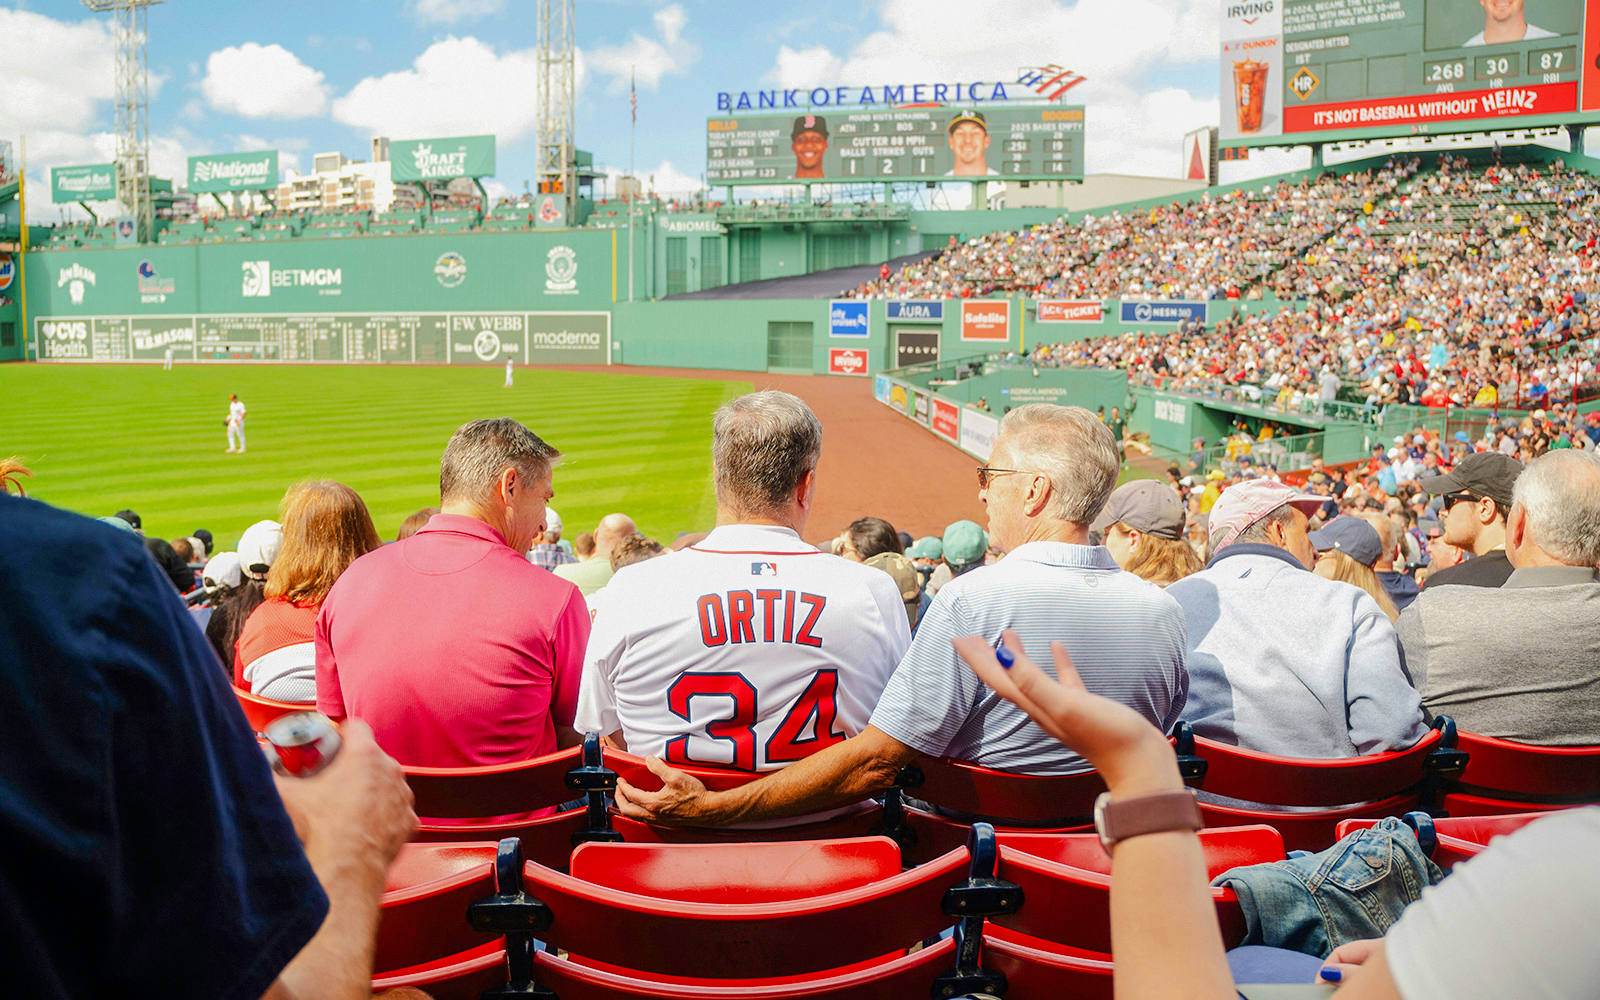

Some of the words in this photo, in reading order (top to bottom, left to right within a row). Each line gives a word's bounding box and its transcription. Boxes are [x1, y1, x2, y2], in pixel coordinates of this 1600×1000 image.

[1228, 1, 1274, 18] IRVING
[1315, 0, 1345, 11] BECAME
[1284, 13, 1317, 24] ATHLETIC
[1319, 10, 1337, 20] WITH
[1338, 5, 1374, 18] MULTIPLE
[1284, 22, 1316, 34] SEASONS
[1335, 17, 1356, 27] SINCE
[1357, 13, 1379, 24] KHRIS
[1242, 38, 1278, 50] DUNKIN'
[1286, 38, 1325, 53] DESIGNATED
[1325, 35, 1350, 48] HITTER
[1486, 57, 1508, 75] 30
[1540, 52, 1563, 70] 87
[1426, 62, 1465, 81] .268
[1543, 73, 1560, 84] RBI
[1294, 76, 1313, 91] HR
[1436, 83, 1454, 93] AVG
[1490, 78, 1503, 88] HR
[717, 89, 798, 110] BANK
[811, 87, 848, 106] OF
[859, 82, 1008, 104] AMERICA
[1314, 110, 1334, 125] IT'S
[1334, 108, 1359, 124] NOT
[1360, 104, 1417, 122] BASEBALL
[1418, 98, 1478, 117] WITHOUT
[1481, 89, 1537, 112] HEINZ
[894, 112, 930, 120] REMAINING
[1042, 110, 1083, 121] ROOKER
[708, 120, 738, 131] BELLO
[839, 124, 856, 133] ATH
[873, 122, 880, 132] 3
[896, 122, 913, 131] BOS
[930, 121, 937, 131] 3
[1032, 122, 1056, 131] BASES
[1058, 122, 1082, 131] EMPTY
[758, 129, 780, 138] COUNT
[852, 136, 888, 147] CUTTER
[891, 136, 903, 146] 88
[906, 135, 926, 145] MPH
[840, 148, 866, 157] BALLS
[872, 147, 905, 156] STRIKES
[912, 146, 934, 155] OUTS
[1007, 141, 1027, 151] .251
[1052, 140, 1063, 151] 19
[415, 152, 467, 168] DRAFT
[850, 159, 856, 174] 1
[883, 158, 893, 174] 2
[920, 157, 926, 173] 1
[1013, 162, 1020, 173] 2
[1052, 162, 1063, 172] 14
[211, 158, 270, 179] National
[421, 165, 465, 177] KINGS
[669, 220, 720, 232] ABIOMED
[72, 262, 96, 287] BEAM
[272, 268, 342, 287] BETMGM
[965, 312, 1006, 324] Safelite
[1042, 305, 1063, 316] ACE
[1063, 304, 1100, 319] TICKET
[1153, 307, 1177, 317] NESN
[56, 321, 87, 340] CVS
[479, 316, 523, 331] WEBB
[533, 330, 601, 345] moderna
[44, 339, 88, 358] Health
[898, 345, 938, 354] VOLVO
[834, 355, 863, 367] IRVING
[697, 588, 827, 649] ORTIZ
[665, 668, 848, 772] 34
